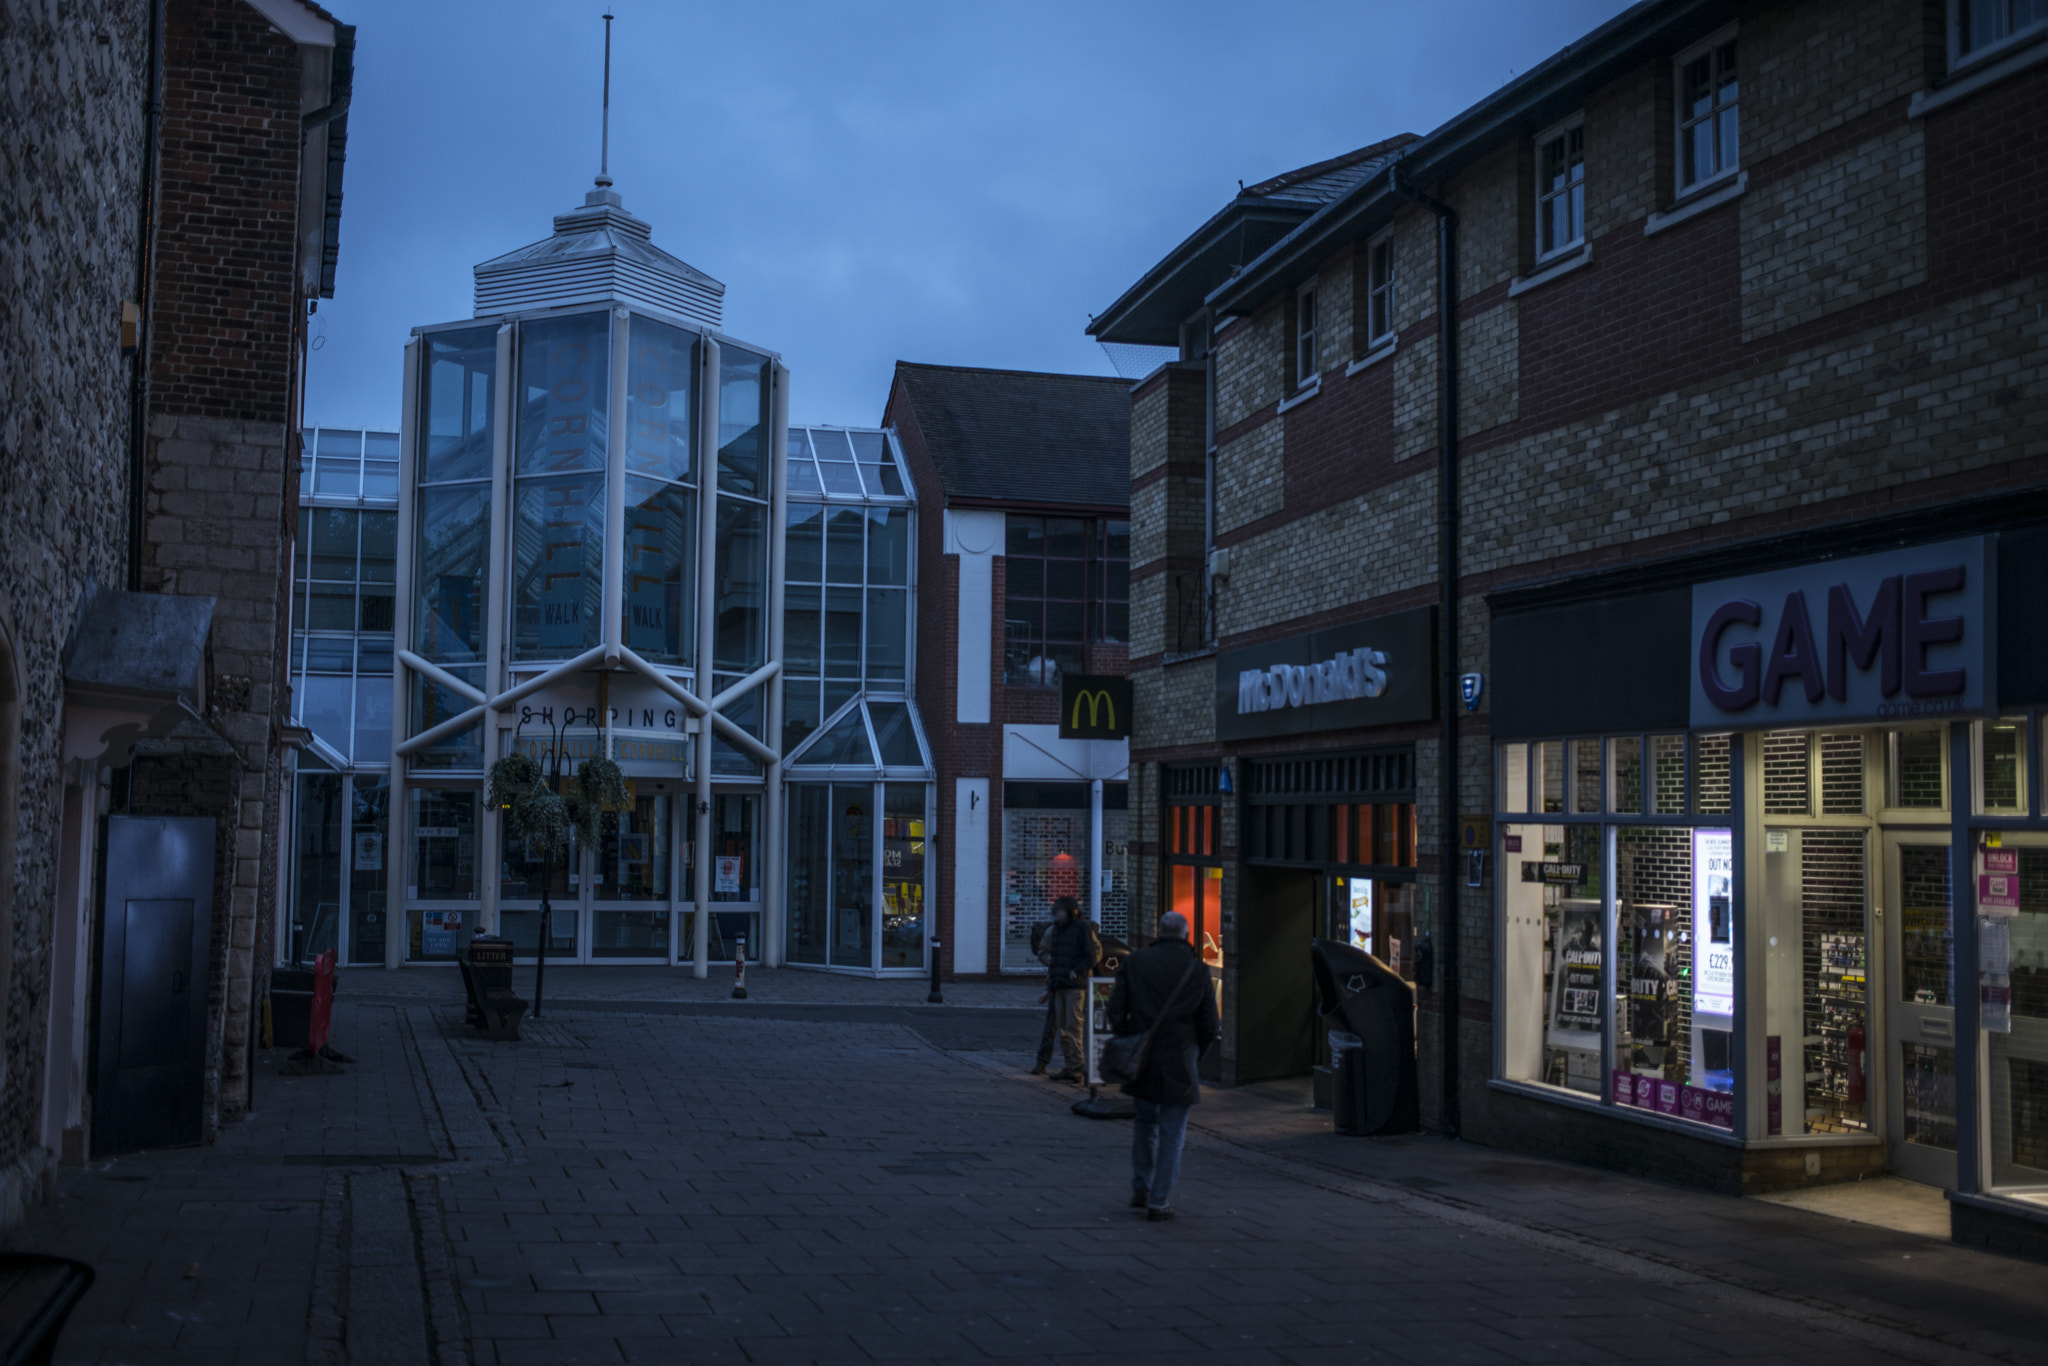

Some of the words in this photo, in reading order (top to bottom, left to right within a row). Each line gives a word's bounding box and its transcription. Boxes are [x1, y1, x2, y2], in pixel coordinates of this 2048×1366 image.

[545, 341, 589, 592] CORNHILL
[544, 601, 580, 625] WALK
[633, 602, 662, 629] WALK
[1699, 564, 1966, 712] GAME
[521, 705, 676, 728] SHOPPING
[1876, 696, 1966, 720] game.co.uk
[518, 740, 595, 758] CORNHILL
[620, 740, 685, 763] CORNHILL
[1709, 858, 1721, 870] OUT
[477, 952, 507, 960] LITTER
[1706, 1096, 1734, 1115] GAME
